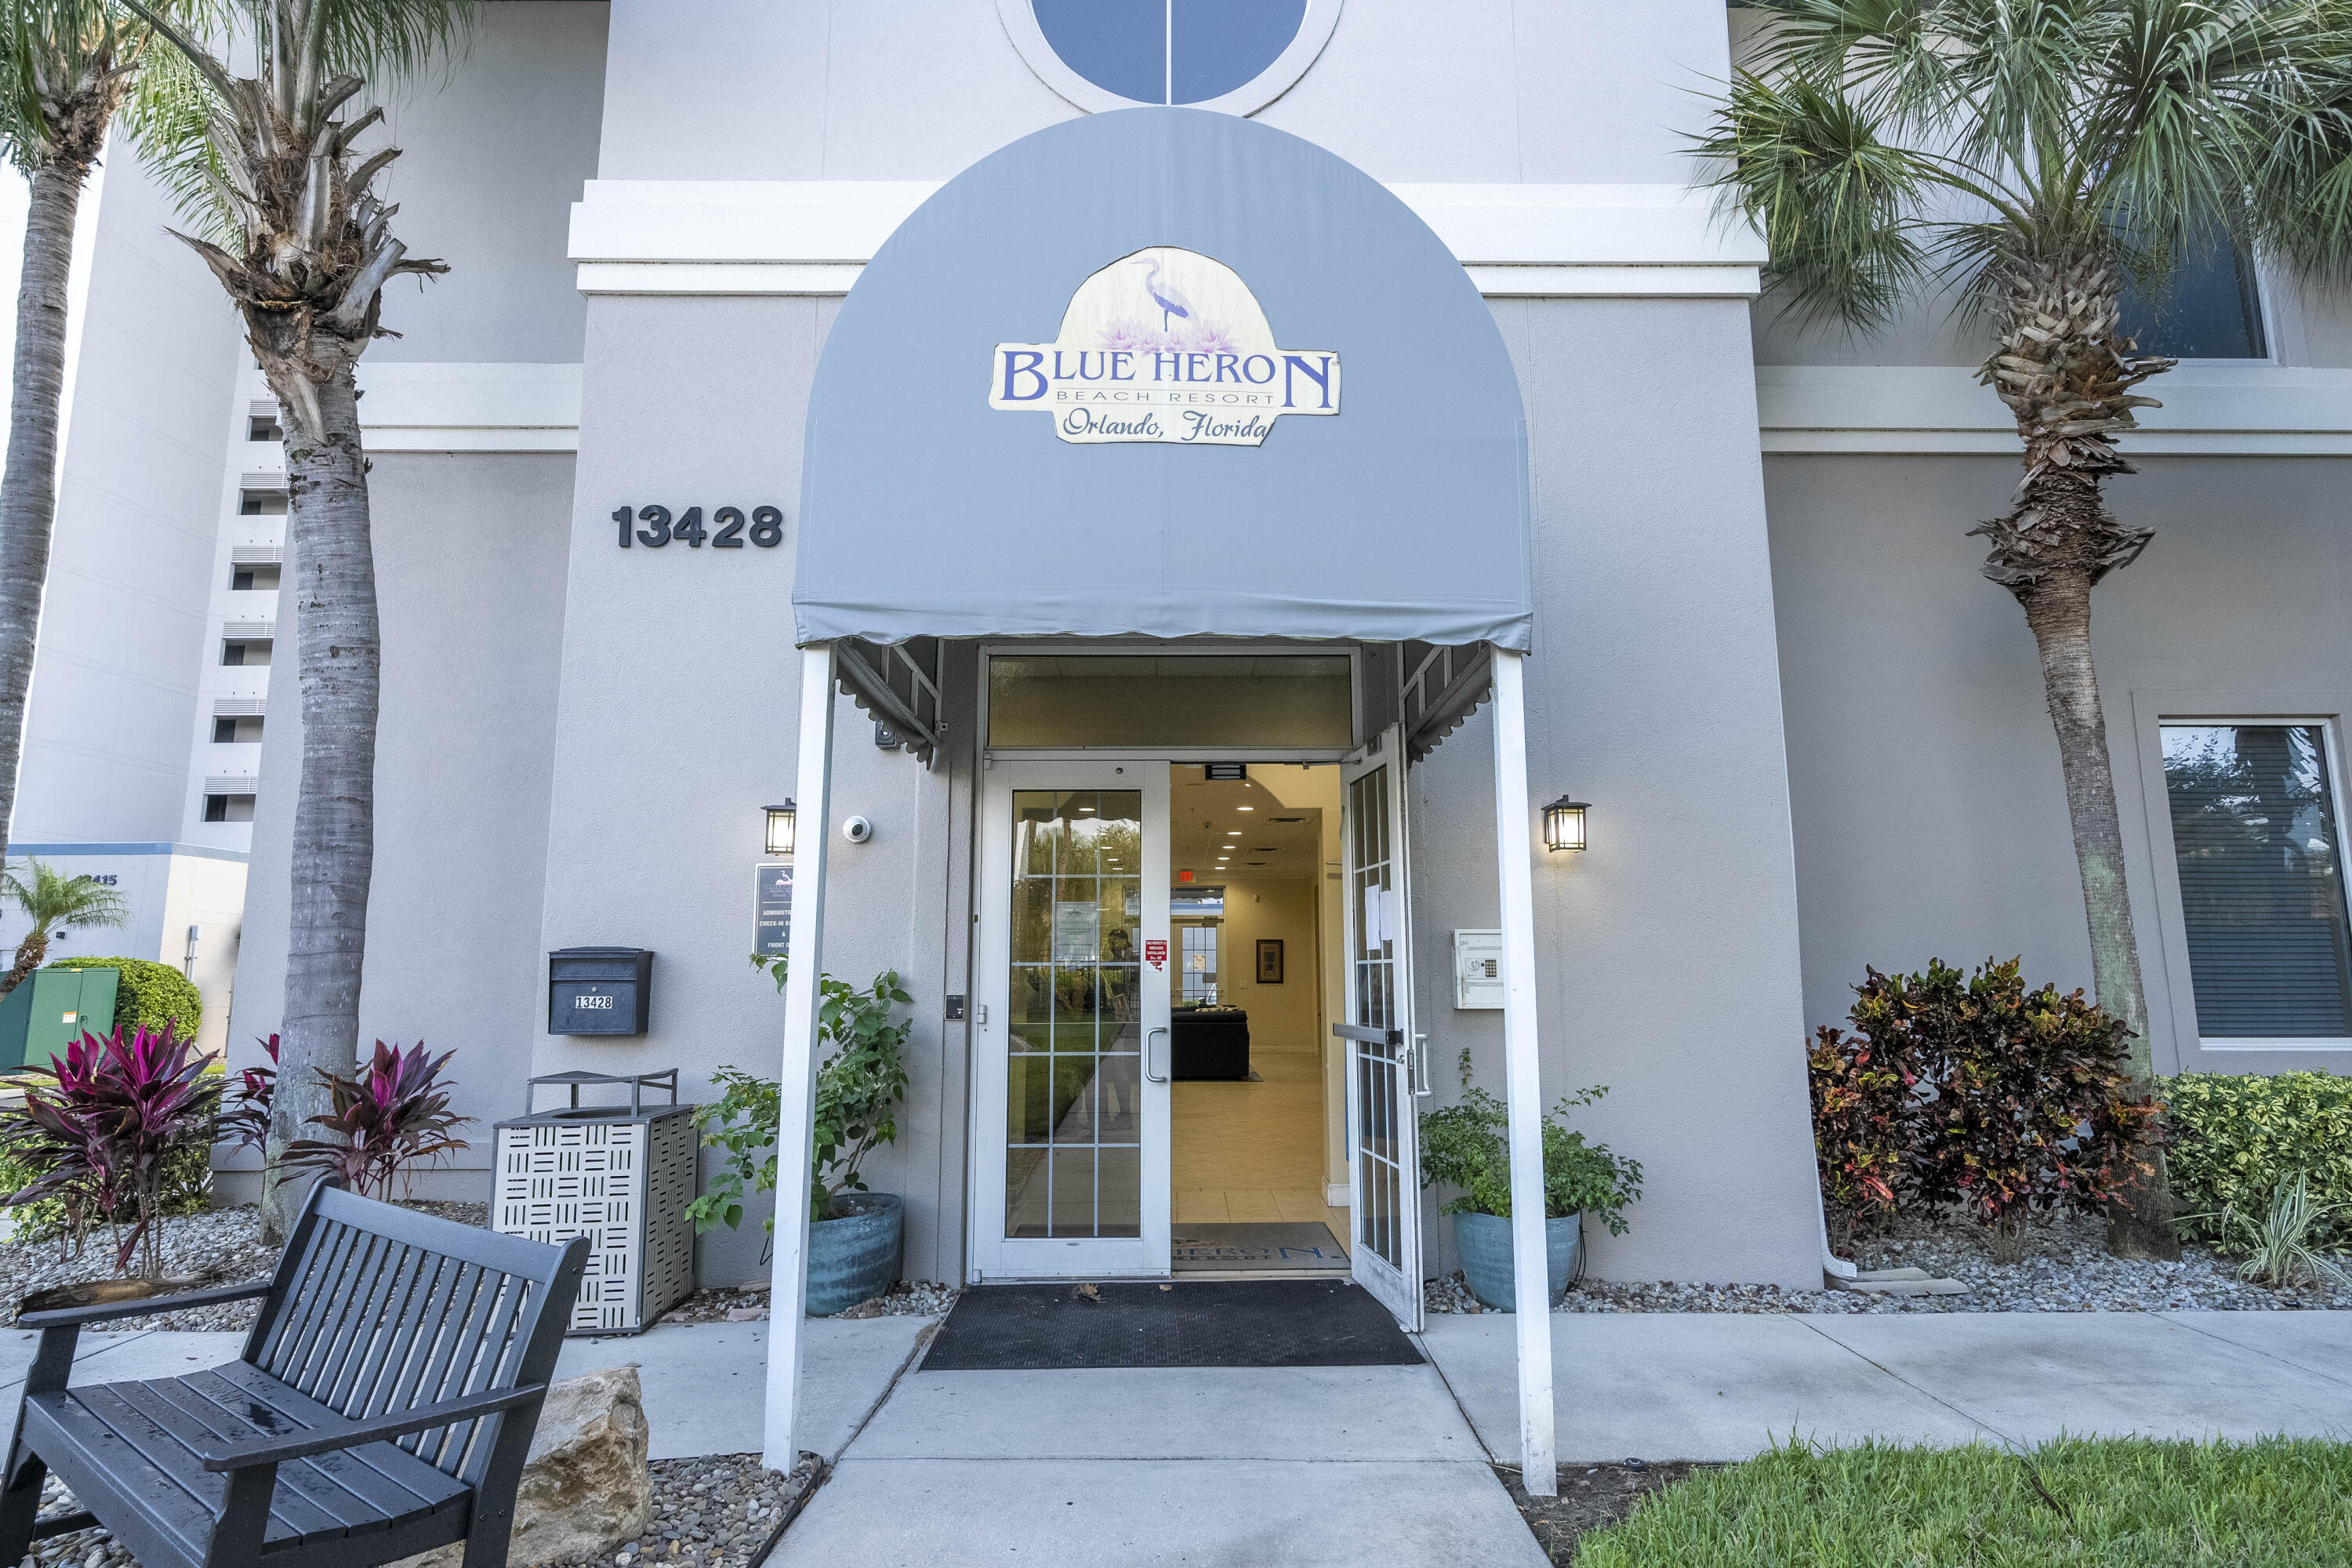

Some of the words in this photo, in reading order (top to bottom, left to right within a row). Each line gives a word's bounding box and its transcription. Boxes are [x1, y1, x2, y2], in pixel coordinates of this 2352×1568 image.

[999, 350, 1137, 401] BLUE
[1152, 352, 1334, 408] HERON
[1057, 391, 1150, 401] BEACH
[1169, 393, 1274, 405] RESORT
[1063, 407, 1164, 438] Orlando,
[1180, 410, 1269, 441] Florida
[612, 504, 782, 548] 13428
[576, 996, 612, 1008] 13428
